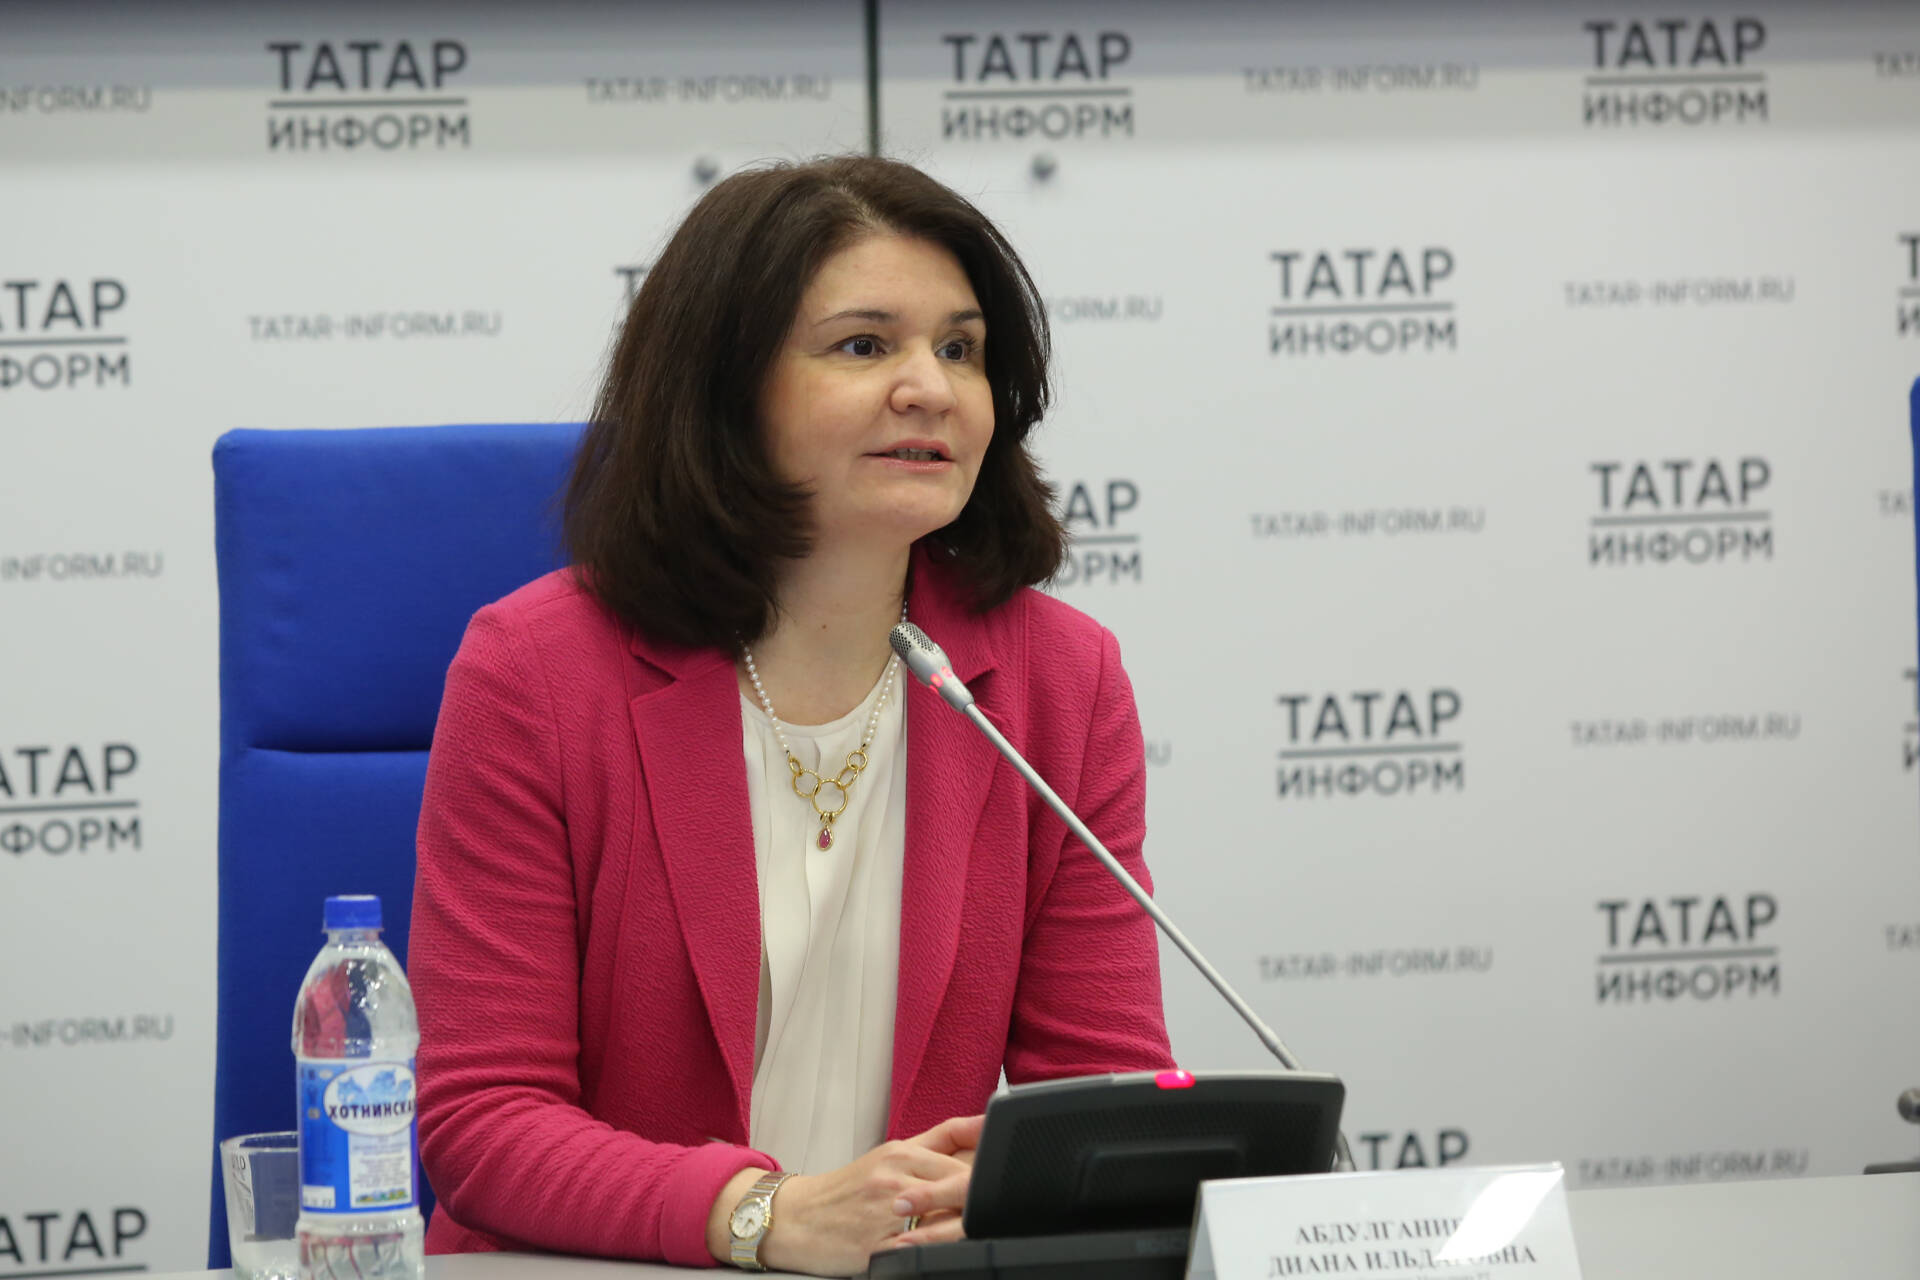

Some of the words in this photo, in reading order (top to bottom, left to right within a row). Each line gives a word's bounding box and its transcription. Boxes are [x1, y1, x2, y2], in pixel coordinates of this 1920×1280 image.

[943, 32, 1132, 84] ТАТАР
[1586, 18, 1767, 70] ТАТАР
[268, 40, 468, 93] ТАТАР
[942, 98, 1134, 141] ИНФОРМ
[1584, 88, 1769, 125] ИНФОРМ
[268, 113, 471, 151] ИНФОРМ
[1270, 247, 1455, 299] ТАТАР
[0, 279, 127, 331] ТАР
[248, 311, 502, 341] TATAR-INFORM.RU
[1269, 319, 1457, 356] ИНФОРМ
[1591, 457, 1772, 510] ТАТАР
[1590, 526, 1774, 565] ИНФОРМ
[1278, 688, 1462, 742] ТАТАР
[1277, 759, 1465, 799] ИНФОРМ
[1598, 894, 1778, 948] ТАТАР
[1597, 964, 1781, 1004] ИНФОРМ
[1268, 1253, 1359, 1278] ДИАНА
